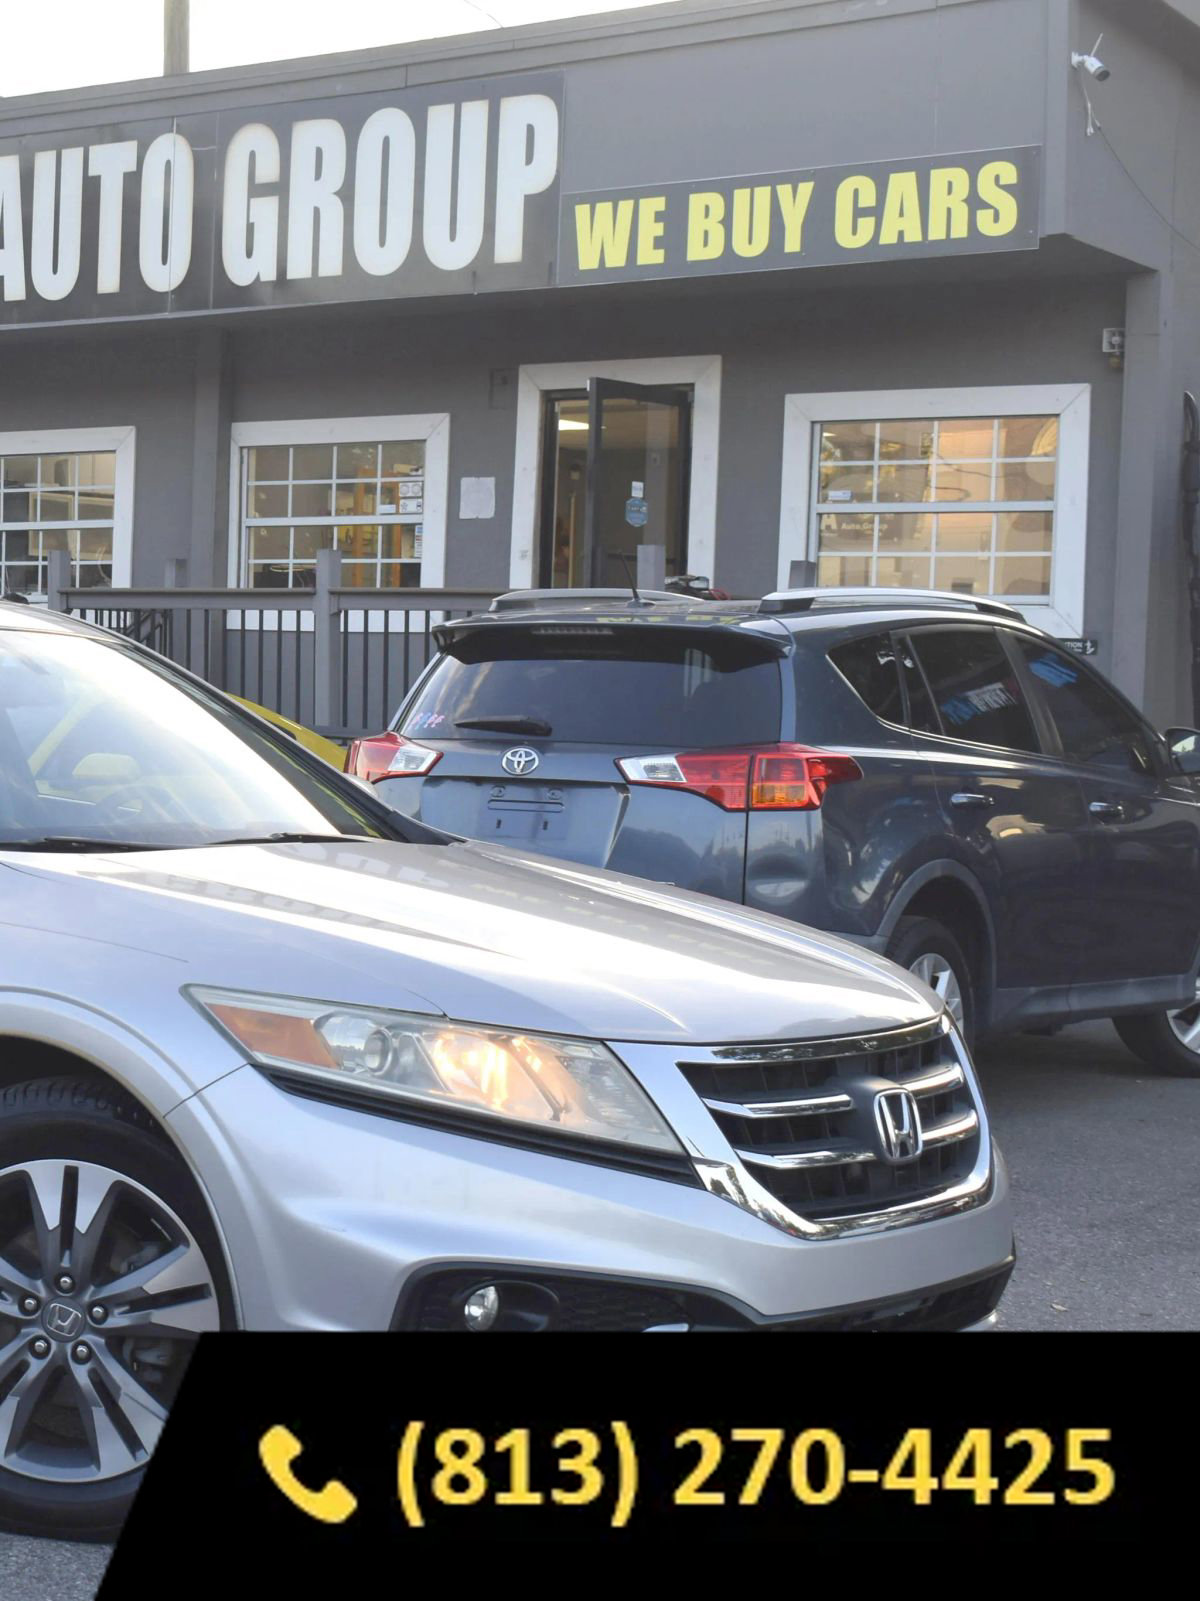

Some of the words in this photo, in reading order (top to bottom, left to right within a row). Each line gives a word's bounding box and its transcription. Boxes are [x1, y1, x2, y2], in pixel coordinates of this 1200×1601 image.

[221, 94, 560, 288] GROUP
[574, 196, 667, 271] WE
[686, 181, 815, 262] BUY
[834, 161, 1019, 249] CARS
